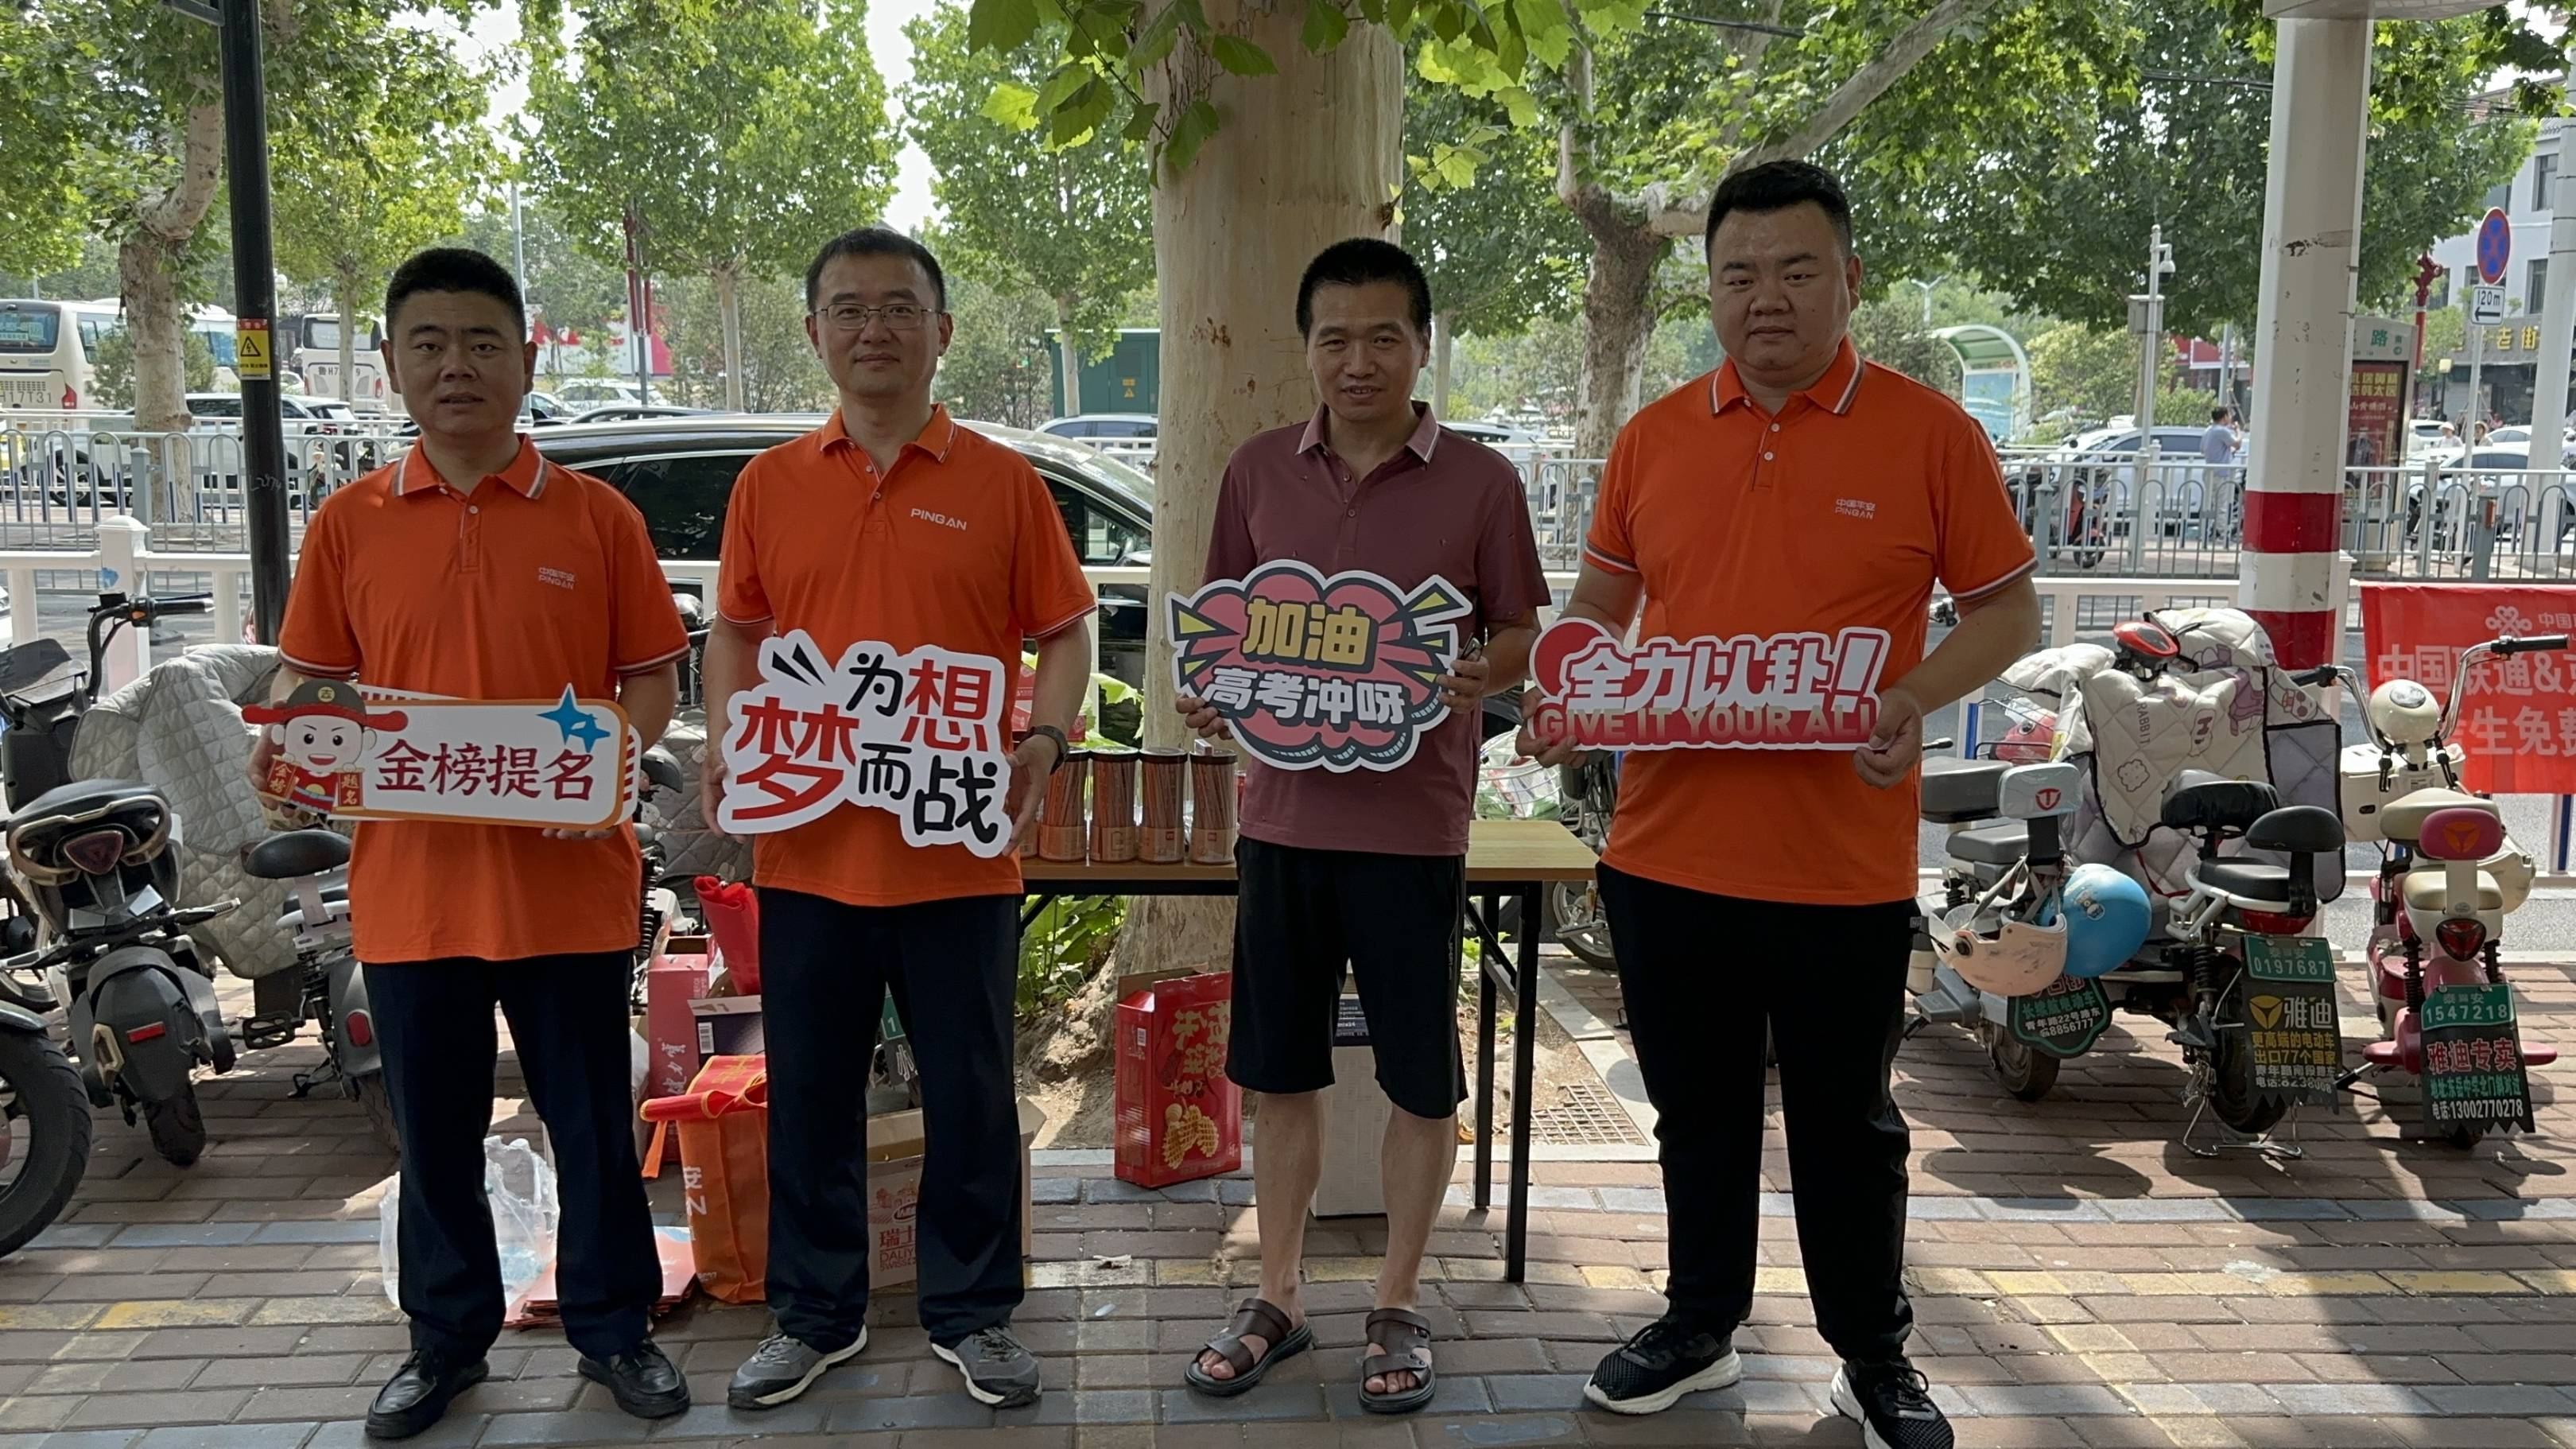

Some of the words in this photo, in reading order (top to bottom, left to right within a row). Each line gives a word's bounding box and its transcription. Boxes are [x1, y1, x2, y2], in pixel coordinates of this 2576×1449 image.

[2476, 289, 2500, 307] 120m
[1242, 596, 1371, 666] 加油
[2538, 612, 2576, 628] 中国
[1566, 633, 1877, 713] 全力以赴!
[1204, 666, 1406, 724] 高考冲呀
[1538, 708, 1626, 740] GIVE
[1637, 706, 1672, 740] IT
[1683, 705, 1793, 740] YOUR
[2136, 702, 2151, 744] RABBIT
[269, 763, 292, 794] 金榜
[374, 738, 594, 802] 金榜提名
[342, 774, 360, 805] 题名
[2254, 957, 2326, 976] 0197687
[2049, 1018, 2094, 1035] 8856777
[2283, 996, 2333, 1028] 雅迪
[2426, 1004, 2508, 1024] 1547218
[2252, 1031, 2335, 1049] 更高端的电动车
[2427, 1037, 2516, 1074] 雅迪专卖
[2254, 1050, 2336, 1064] 出口77个国家
[2432, 1099, 2524, 1120] 电话:13002770278
